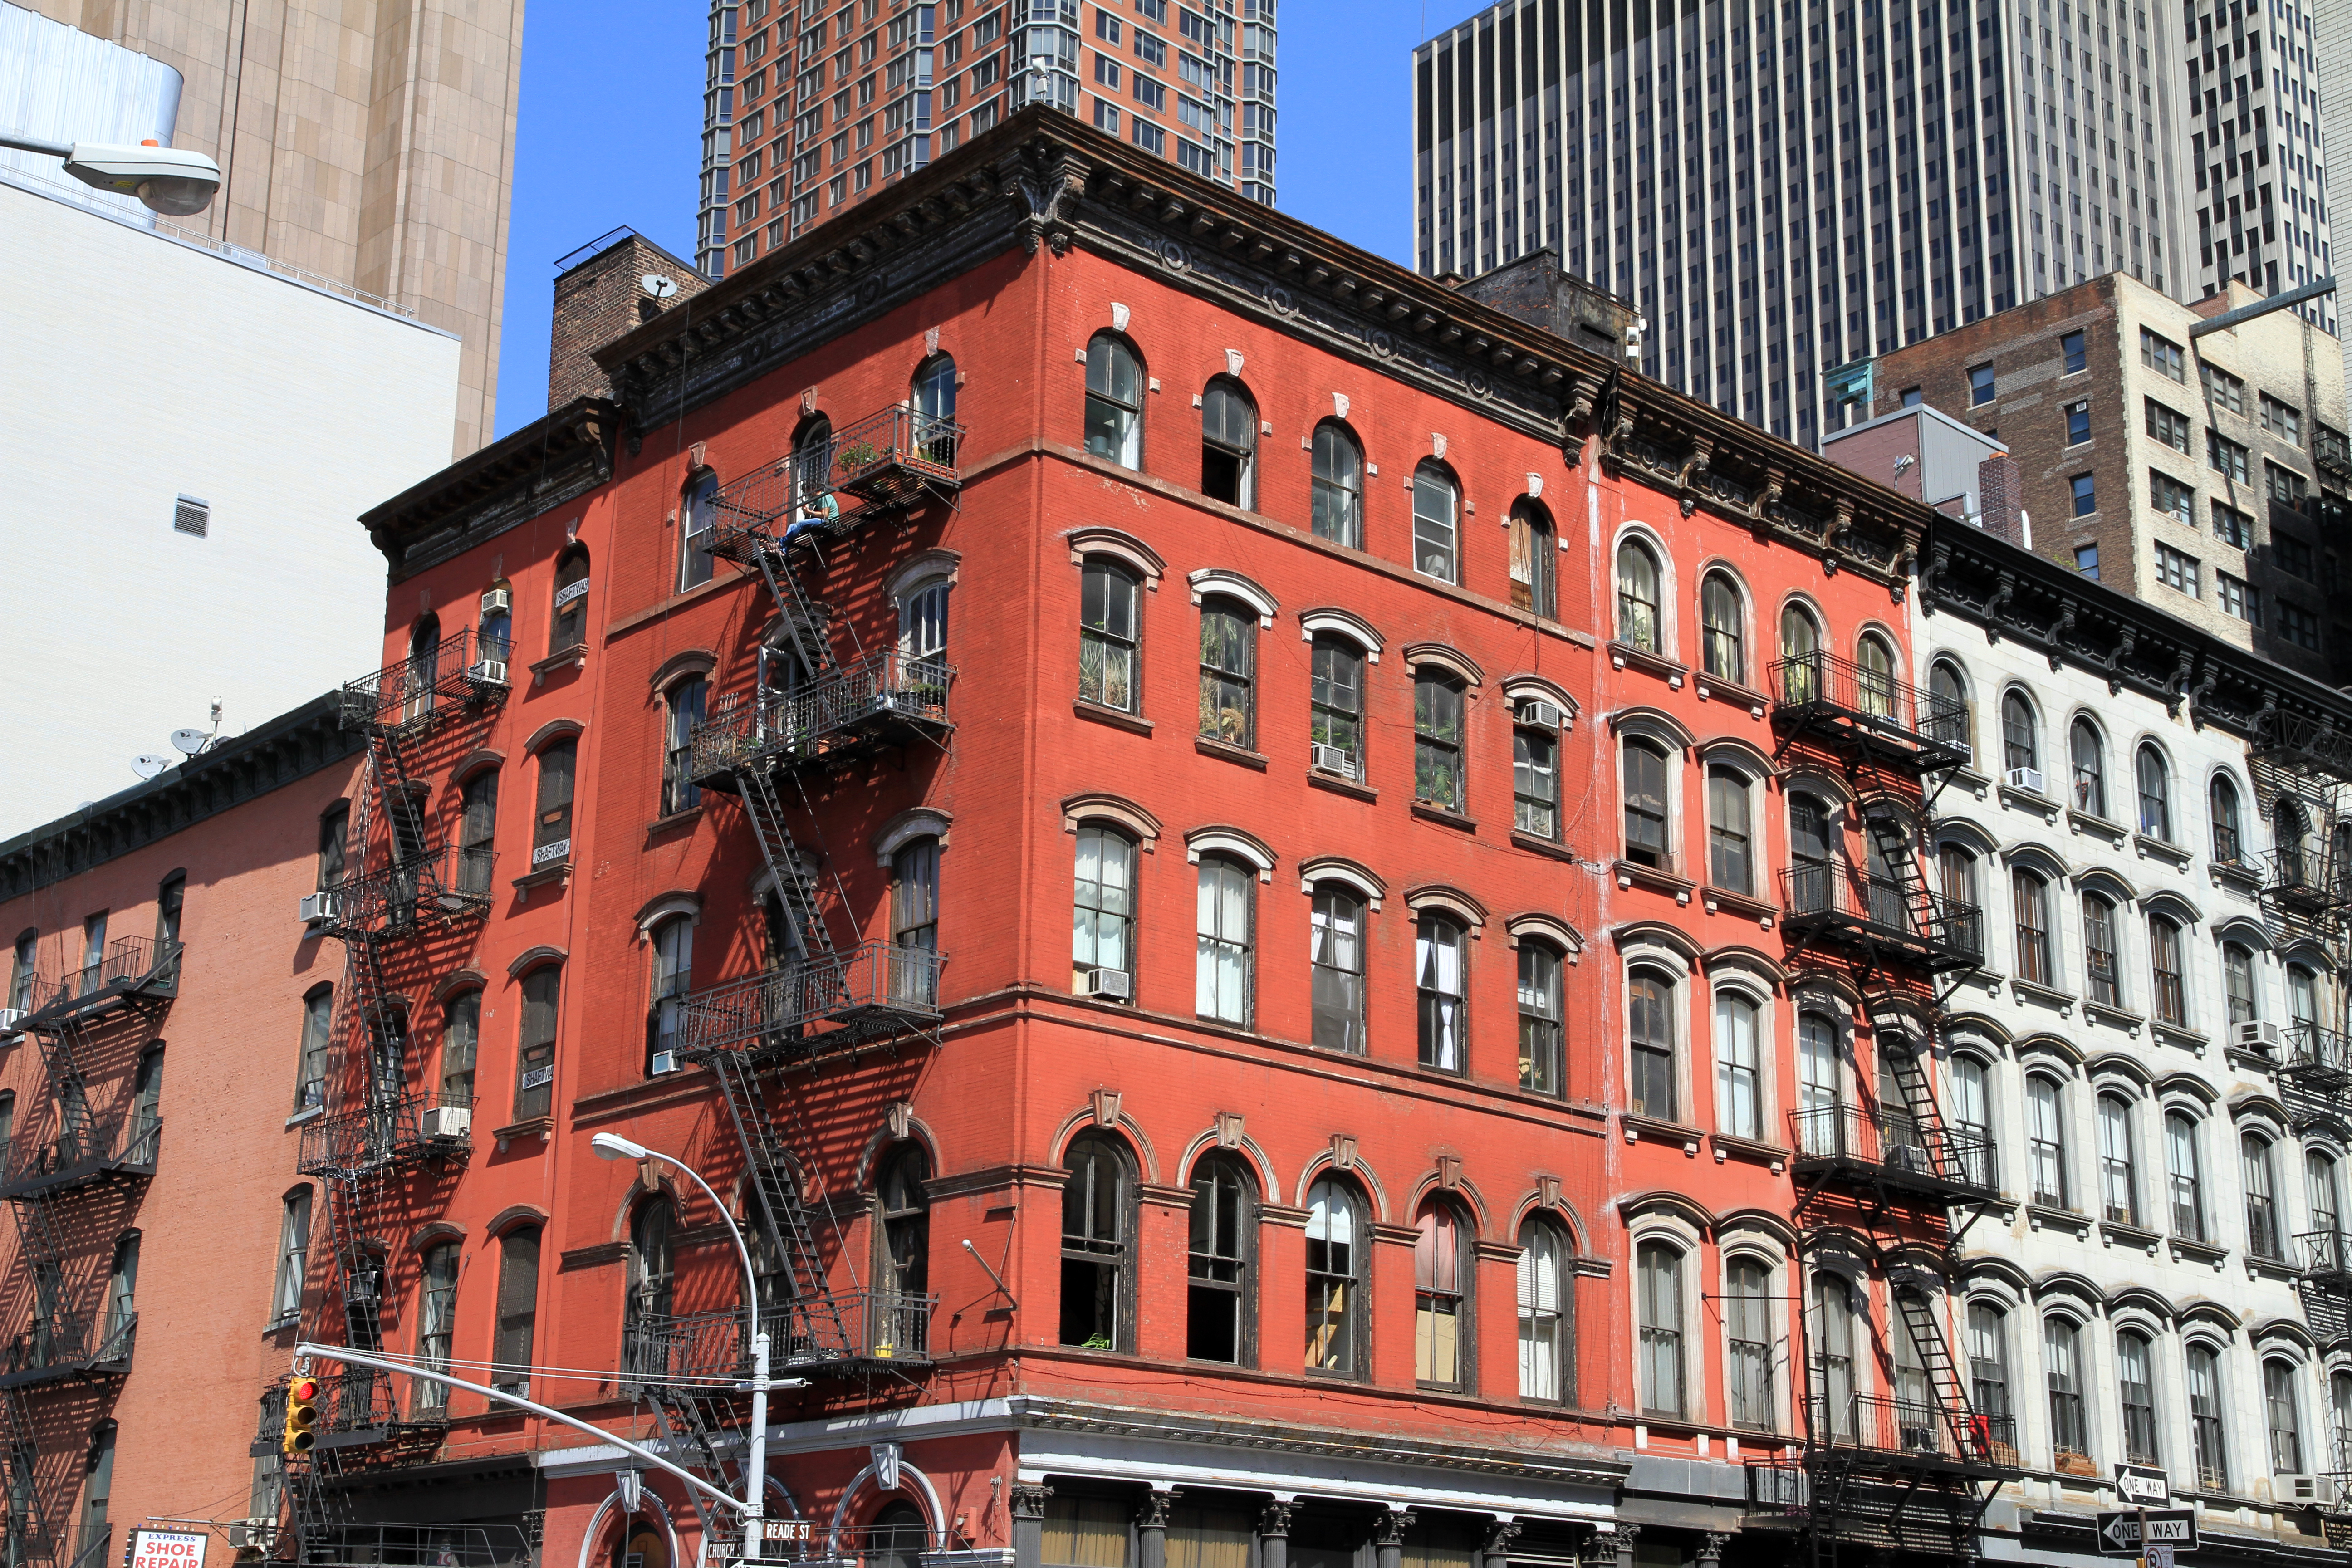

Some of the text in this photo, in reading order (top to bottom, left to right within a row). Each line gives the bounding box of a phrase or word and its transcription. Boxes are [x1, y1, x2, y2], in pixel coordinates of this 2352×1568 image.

[537, 841, 567, 861] SHAFTWAY
[526, 1065, 554, 1086] SHAFTWA
[2124, 1477, 2162, 1496] ONE WAY
[148, 1533, 196, 1542] EXPRESS
[766, 1524, 810, 1539] READE ST
[2112, 1522, 2182, 1539] ONE WAY
[145, 1542, 195, 1556] SHOE
[708, 1543, 735, 1558] CHURCH
[135, 1556, 198, 1568] REPAIR
